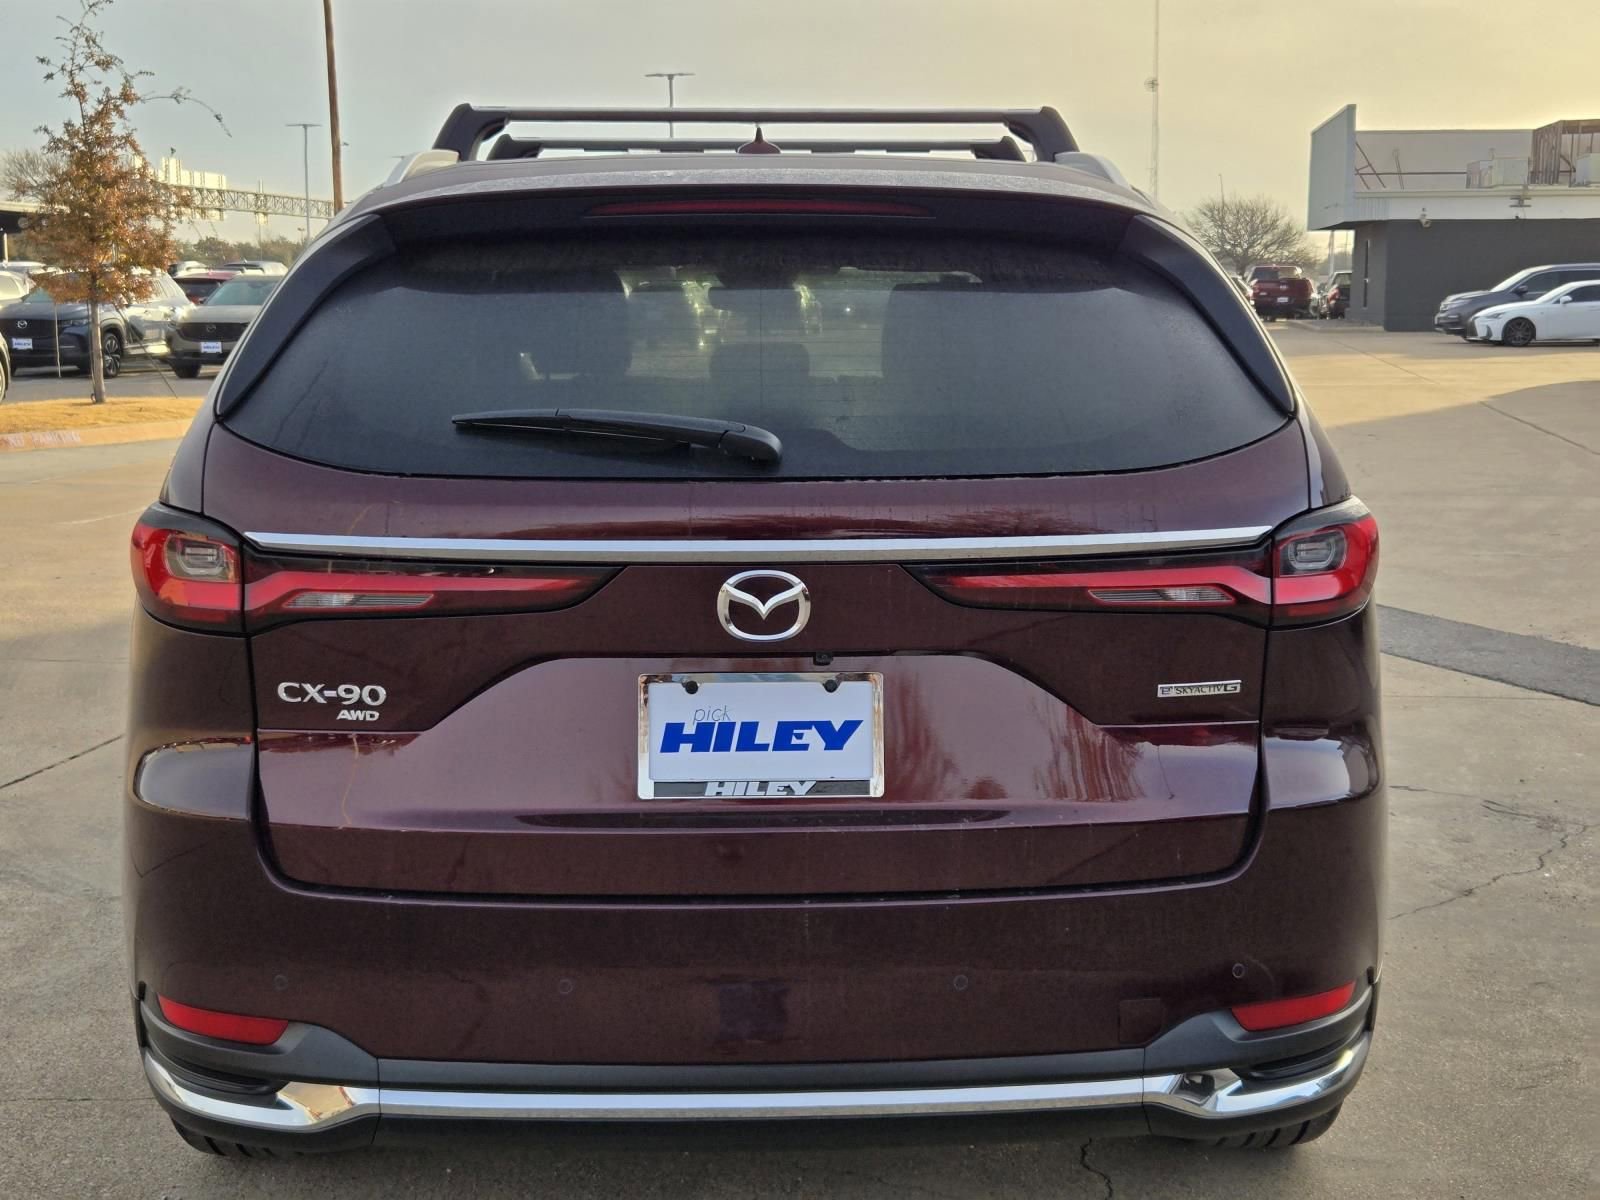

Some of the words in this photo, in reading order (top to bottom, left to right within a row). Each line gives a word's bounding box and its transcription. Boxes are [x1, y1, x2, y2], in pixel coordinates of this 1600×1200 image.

[277, 682, 387, 706] CX-90
[336, 709, 379, 721] AWD
[693, 705, 731, 726] pick
[660, 719, 864, 753] HILEY
[704, 780, 816, 796] HILEY
